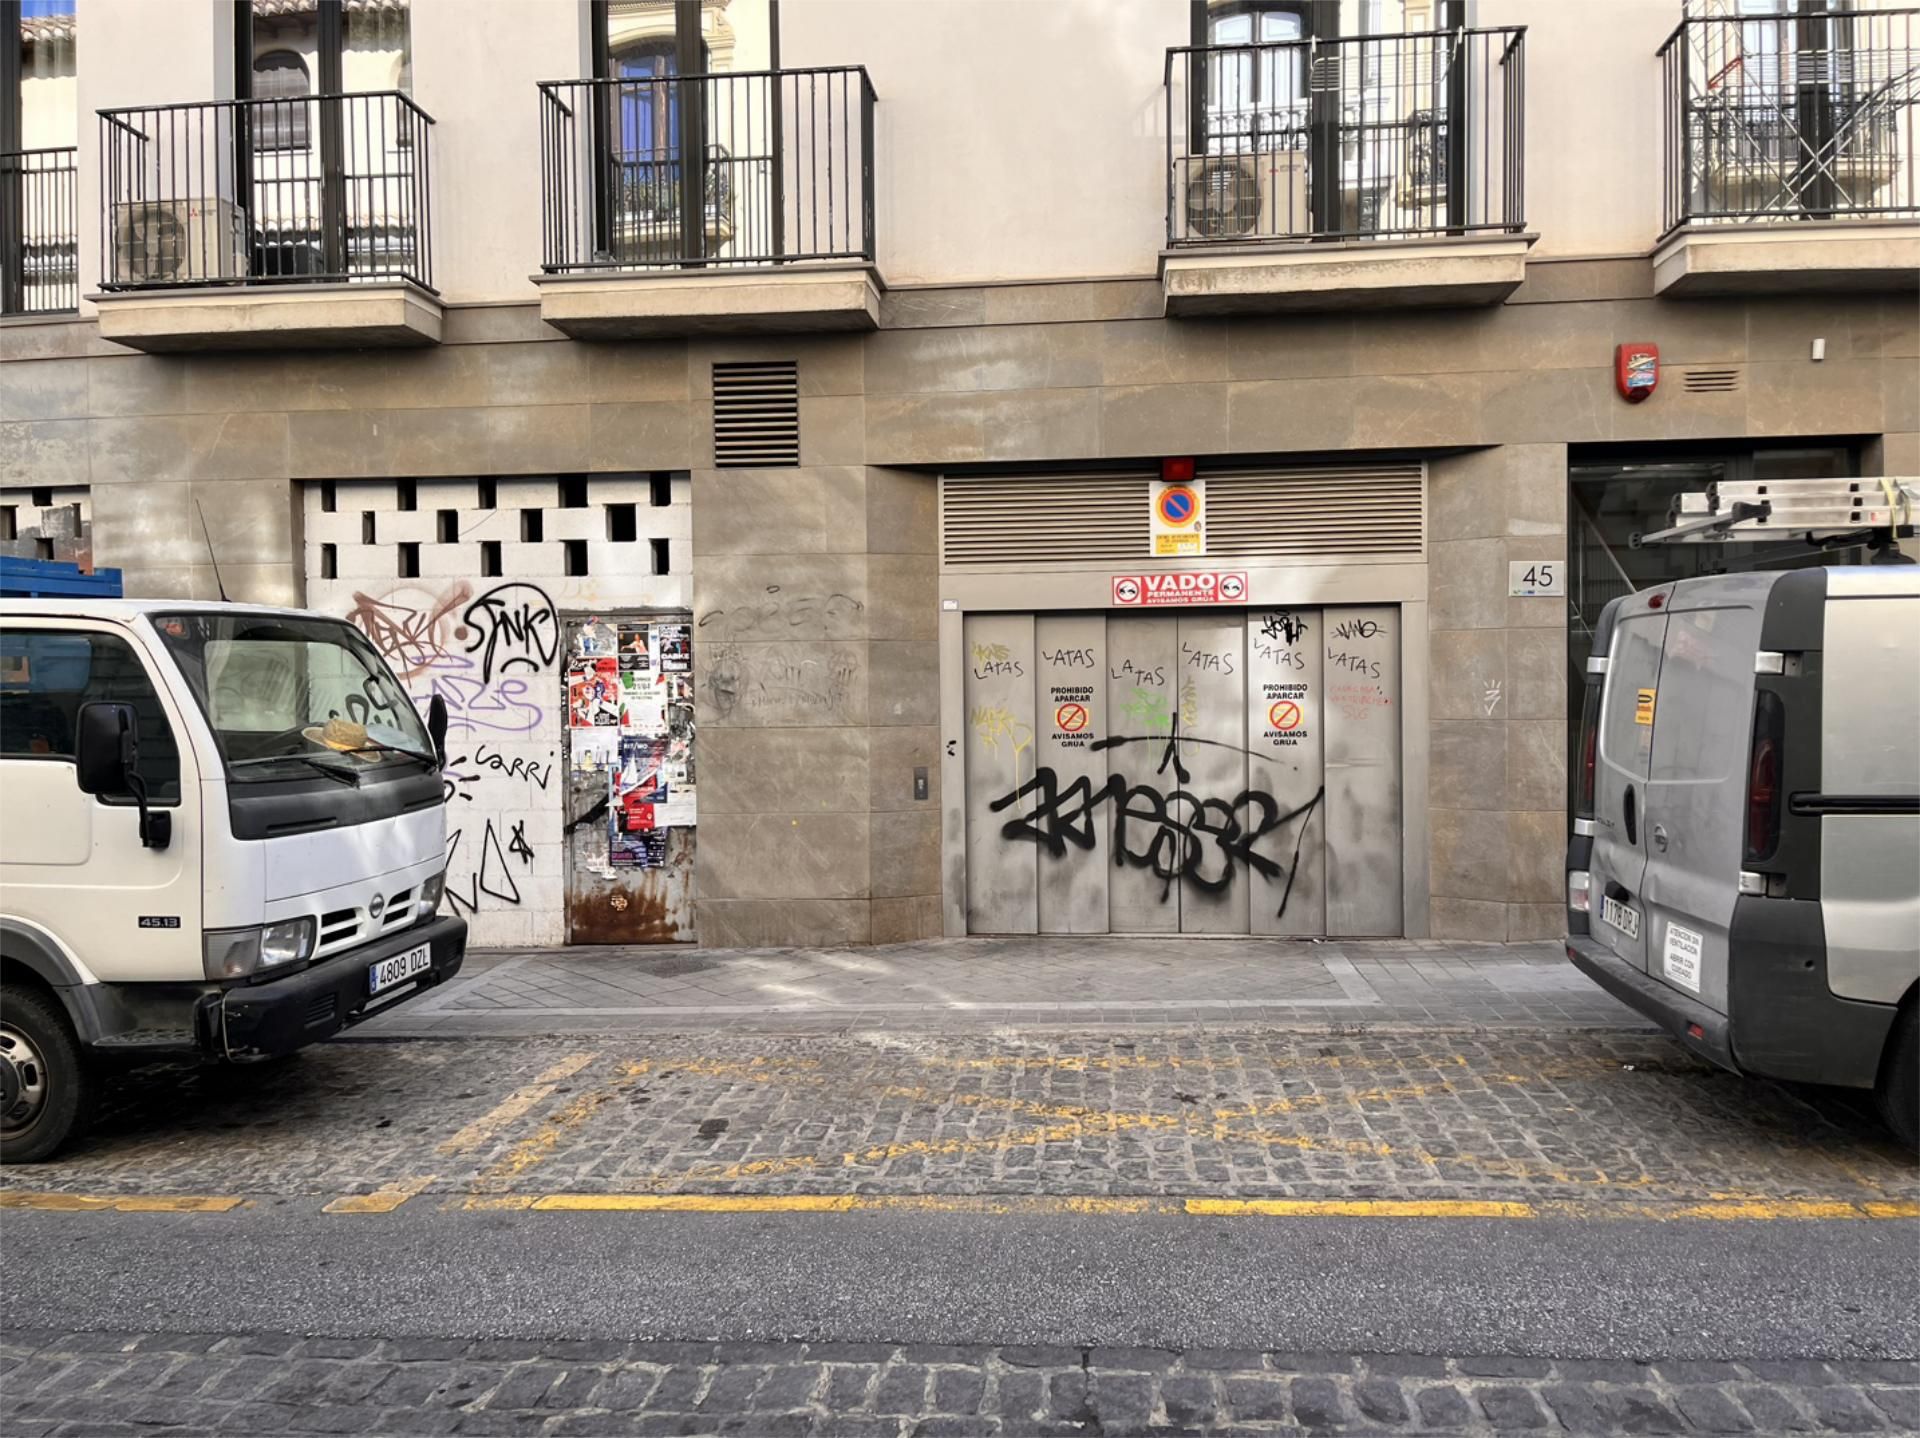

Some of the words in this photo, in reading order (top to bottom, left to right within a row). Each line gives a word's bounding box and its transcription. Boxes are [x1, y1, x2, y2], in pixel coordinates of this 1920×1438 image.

[1144, 574, 1216, 591] VADO
[1522, 565, 1553, 588] 45
[1147, 589, 1214, 598] PERMANENTE
[1042, 648, 1095, 668] LATAS
[1182, 641, 1234, 675] LATAS
[1253, 638, 1305, 670] LATAS
[1327, 647, 1380, 679] LATAS
[974, 660, 1024, 680] LATAS
[1110, 659, 1165, 687] LATAS
[1050, 686, 1094, 694] PROHIBIDO
[1054, 694, 1090, 702] APARCAR
[1263, 684, 1308, 692] PROHIBIDO
[1266, 692, 1304, 700] APARCAR
[1051, 732, 1094, 740] AVISAMOS
[140, 917, 178, 928] 45.13
[1605, 899, 1623, 926] 1178
[1623, 908, 1637, 935] DRJ
[380, 957, 407, 985] 4809
[411, 947, 429, 972] DZL
